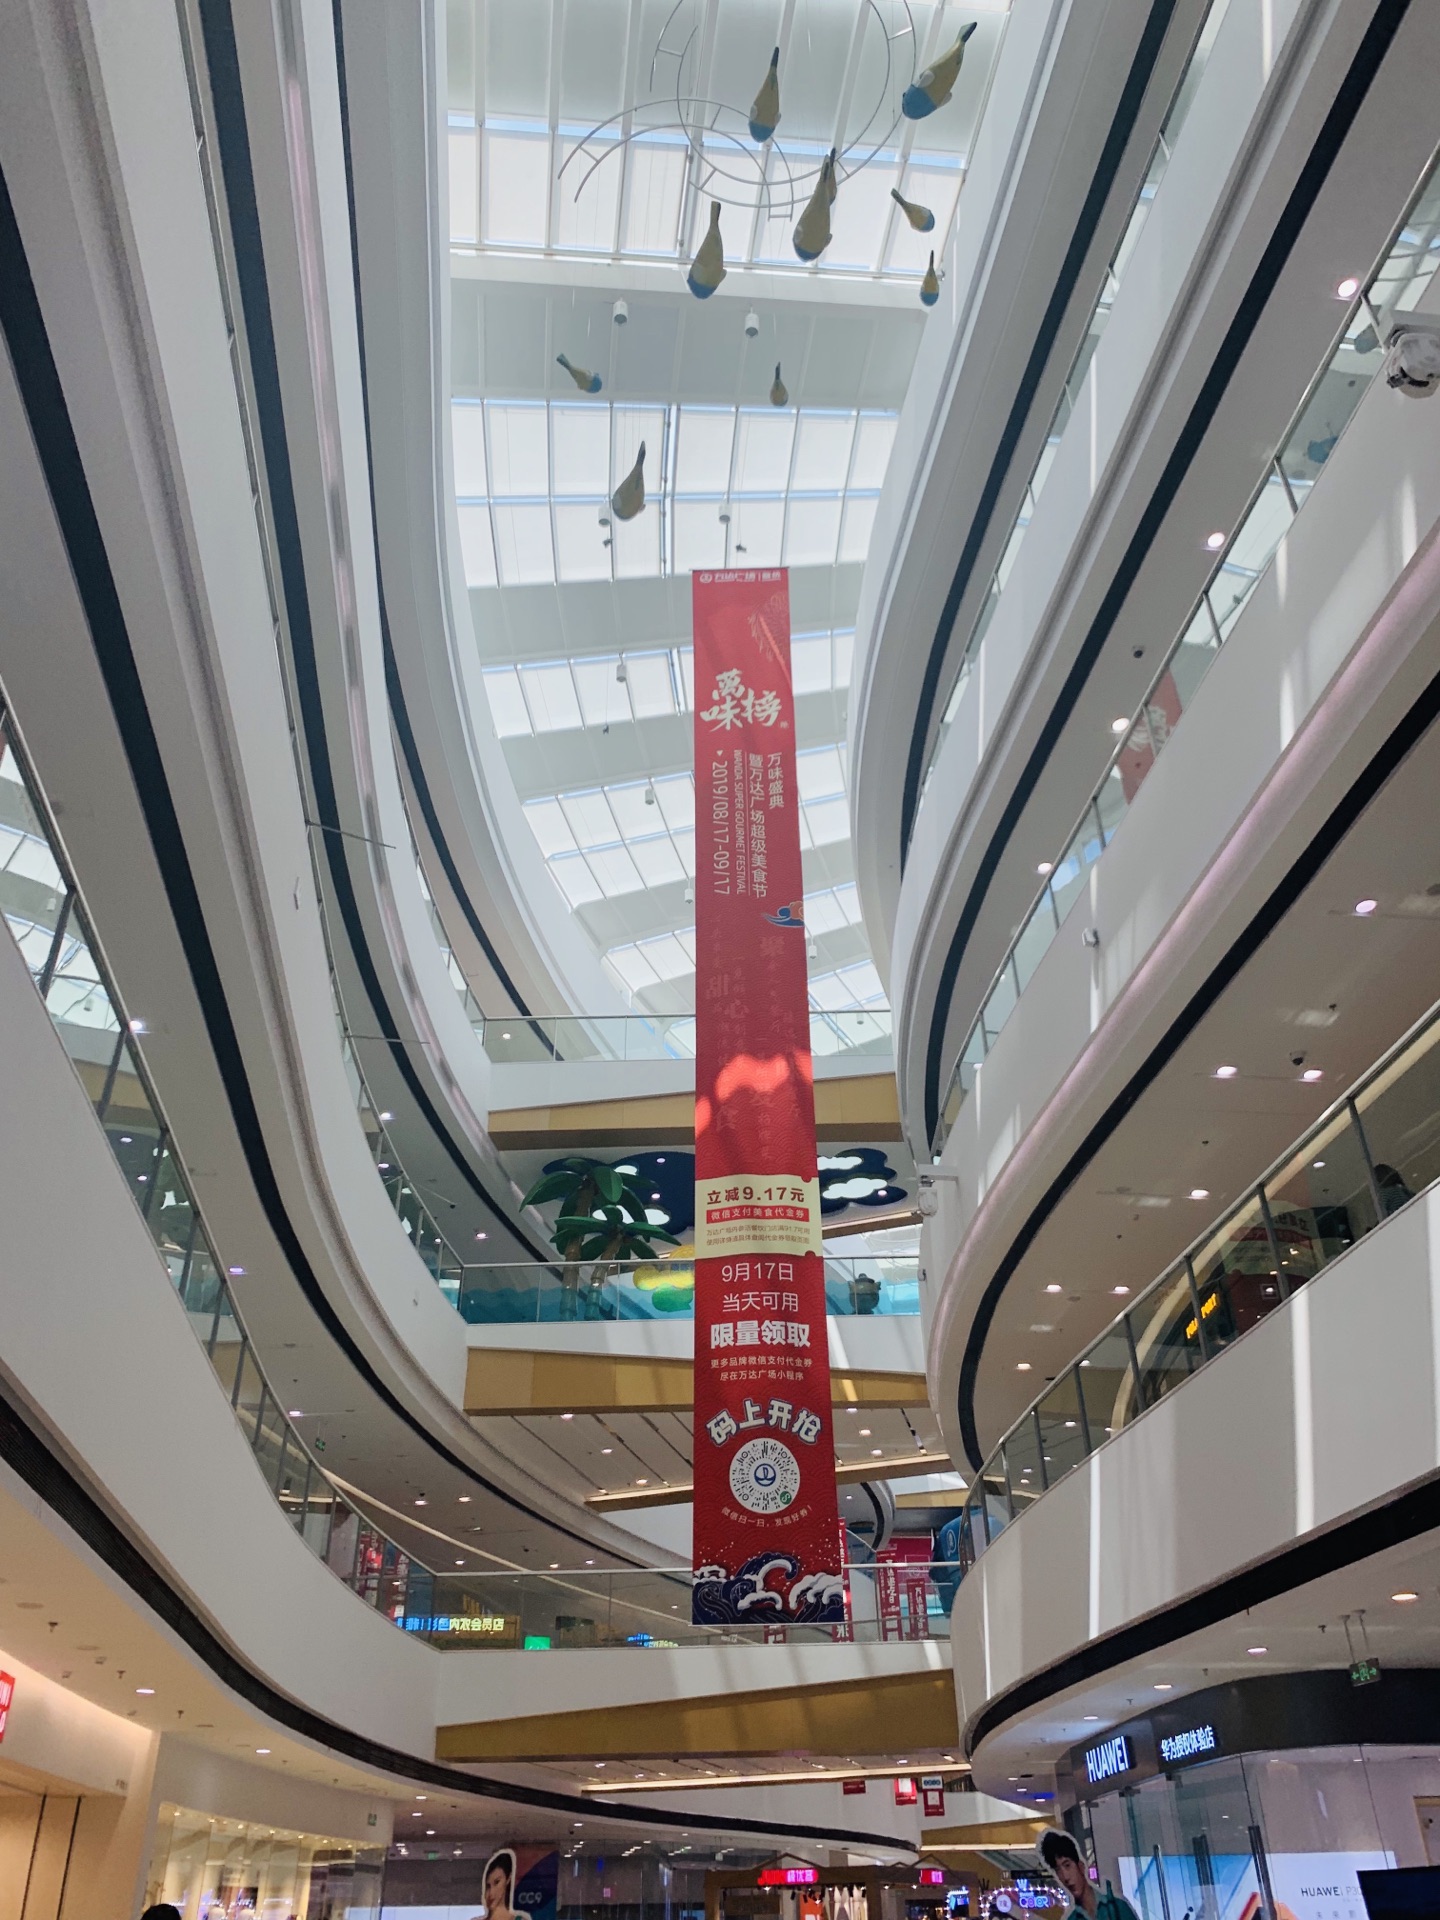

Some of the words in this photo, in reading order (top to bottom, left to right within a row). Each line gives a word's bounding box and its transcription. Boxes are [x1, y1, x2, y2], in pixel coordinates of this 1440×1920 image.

[767, 752, 785, 809] 万味盛典
[734, 781, 744, 809] SUPER
[712, 760, 730, 895] 2019/08/17-09/17
[735, 810, 746, 854] GOURMET
[749, 753, 768, 898] 暨万达广场超级美食节
[736, 855, 746, 895] FESTIVAL
[707, 1186, 805, 1205] 立减9.17元
[711, 1207, 805, 1220] 微信支付美食代金券
[721, 1262, 793, 1282] 9月17日
[722, 1292, 799, 1312] 当天可用
[710, 1320, 811, 1349] 限量领取
[710, 1355, 812, 1369] 更多品牌微信支付代金券
[720, 1369, 804, 1382] 尽在万达广场小程序
[705, 1398, 822, 1446] 码上开抢
[1161, 1725, 1215, 1762] 华为授权体验店
[1085, 1735, 1129, 1783] HUAWEI
[518, 1891, 543, 1904] CC9
[1300, 1886, 1343, 1897] HUAWEI
